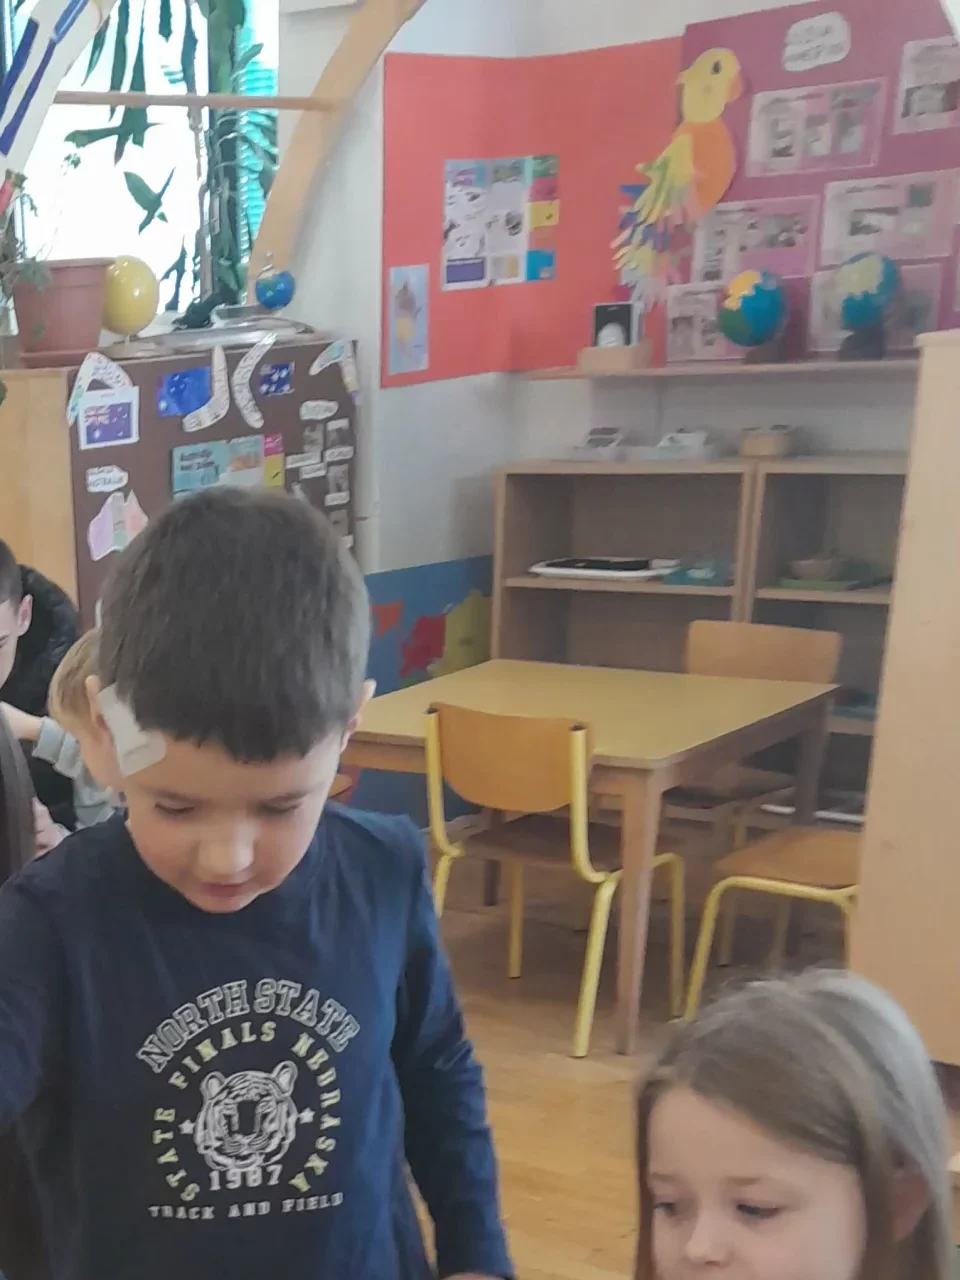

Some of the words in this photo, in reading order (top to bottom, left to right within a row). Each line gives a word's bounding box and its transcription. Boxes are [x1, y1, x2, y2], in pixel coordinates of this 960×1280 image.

[136, 980, 250, 1073] NORTH
[253, 978, 360, 1053] STATE
[168, 1021, 276, 1089] FINALS
[152, 1107, 200, 1201] STATE
[209, 1164, 283, 1191] 1987
[148, 1204, 215, 1220] TRACK
[228, 1201, 271, 1217] AND
[282, 1192, 344, 1212] FIELD
